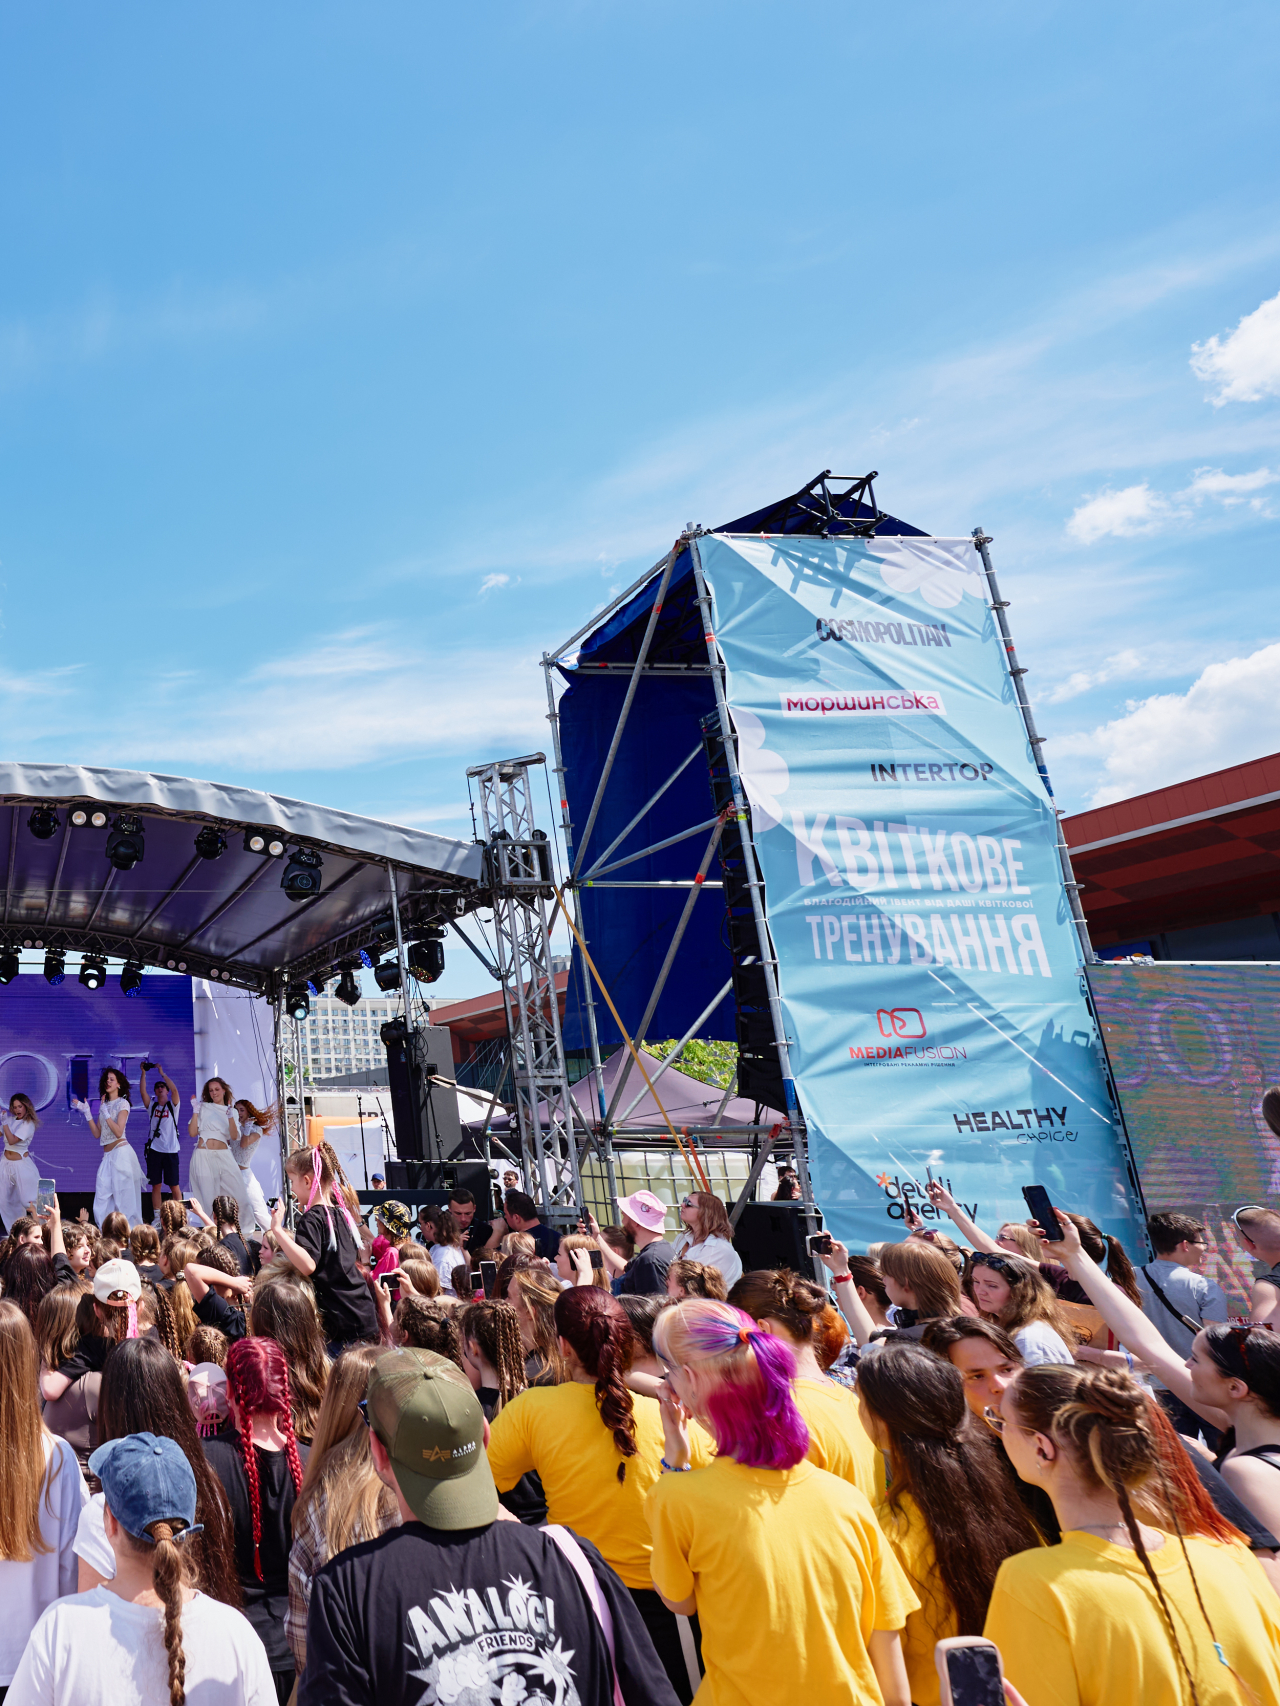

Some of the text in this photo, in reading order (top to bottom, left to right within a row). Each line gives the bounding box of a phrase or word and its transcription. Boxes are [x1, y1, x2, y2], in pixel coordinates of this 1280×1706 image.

[815, 617, 952, 648] COSMOPOLITAN
[786, 691, 940, 715] моршинська
[870, 762, 994, 782] INTERTOP
[790, 810, 1031, 895] КВІТКОВЕ
[803, 897, 1034, 908] БЛАГОДІЙНИЙ ІВЕНТ ВІД ДАШІ КВІТКОВОЇ
[806, 914, 1053, 978] ТРЕНУВАННЯ
[848, 1046, 967, 1060] MEDIAFUSION
[953, 1106, 1067, 1133] HEALTHY
[887, 1202, 978, 1223] aey
[406, 1585, 556, 1663] ANALOG!
[477, 1633, 535, 1653] FRIENDS
